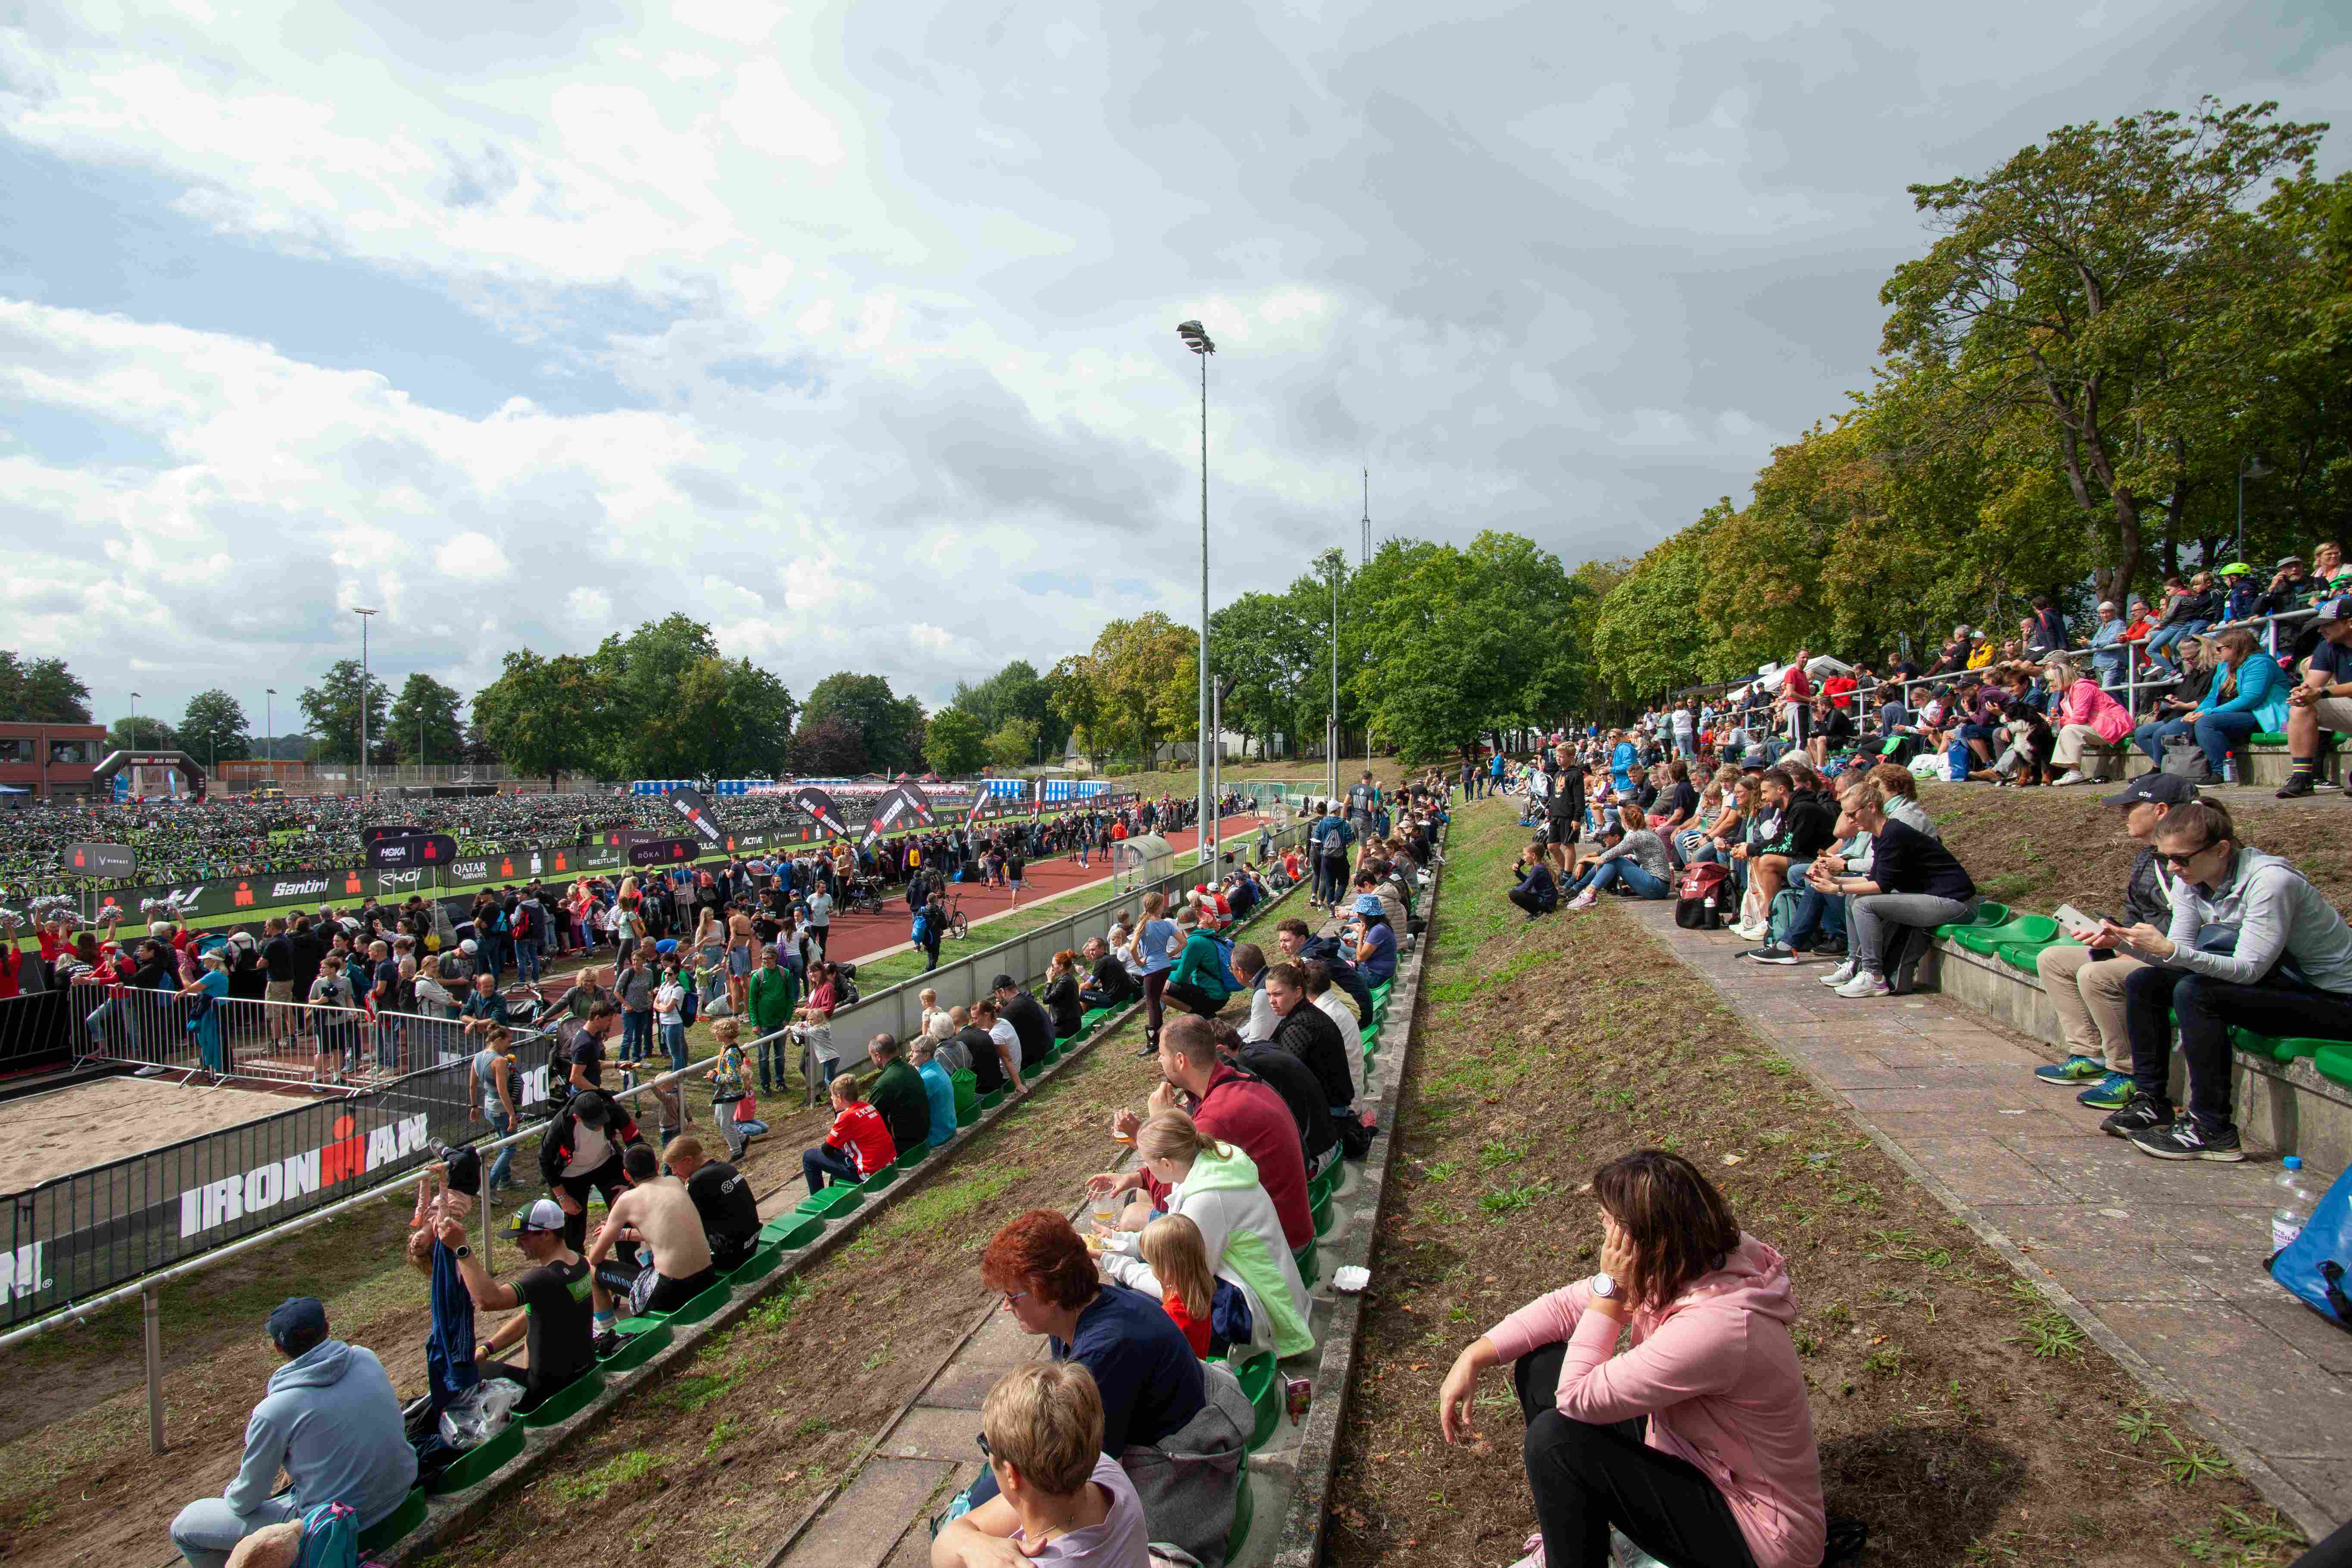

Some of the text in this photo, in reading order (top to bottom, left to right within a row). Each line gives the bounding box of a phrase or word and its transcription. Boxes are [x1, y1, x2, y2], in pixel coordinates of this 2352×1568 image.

[741, 836, 763, 846] ACTIVE
[381, 846, 406, 857] HOKA
[588, 856, 619, 865] BREITLING
[453, 862, 486, 875] QATAR
[462, 871, 487, 880] AIRWAYS
[272, 878, 330, 897] Santini
[178, 905, 199, 914] yperice
[180, 1112, 428, 1238] IRONMAN
[602, 1272, 632, 1289] CANYON
